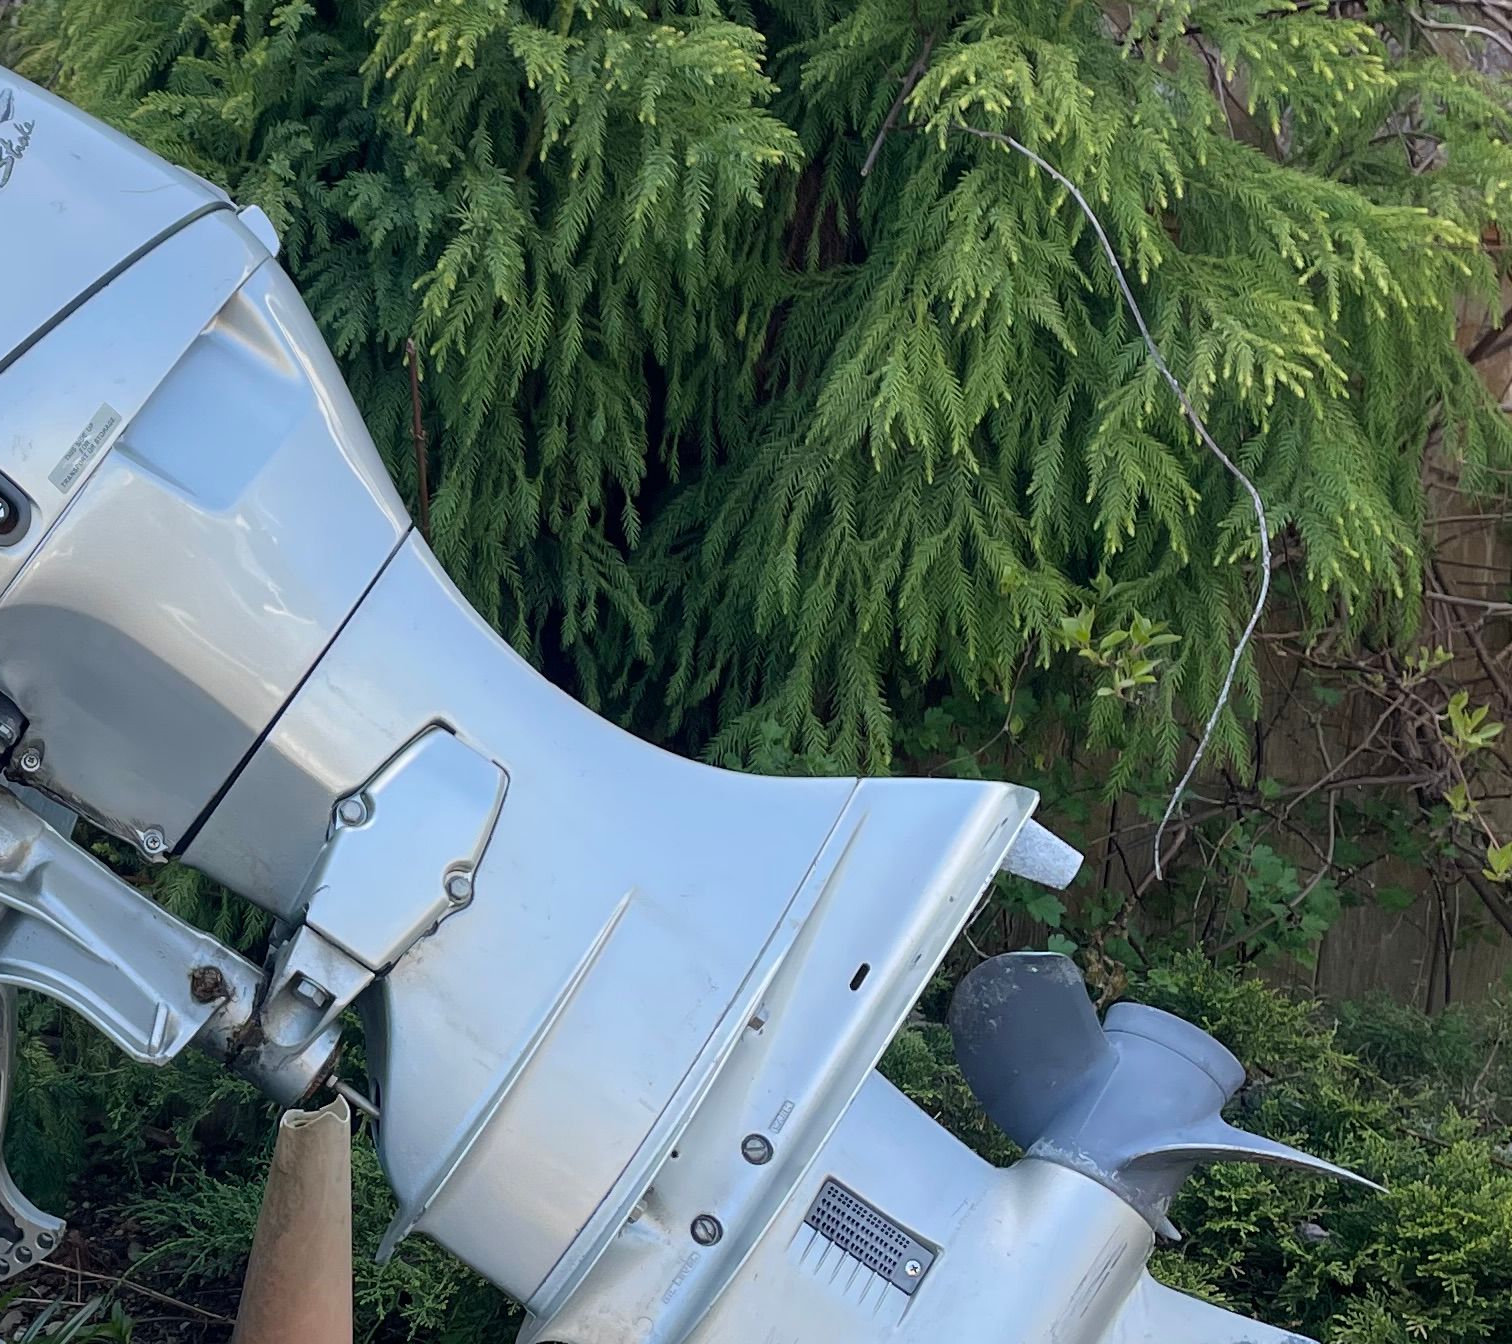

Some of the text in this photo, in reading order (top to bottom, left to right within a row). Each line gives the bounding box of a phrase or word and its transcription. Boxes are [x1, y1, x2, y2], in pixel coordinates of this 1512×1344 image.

[60, 416, 116, 488] TRANSPORT OR STORAGE
[78, 440, 91, 454] FOR
